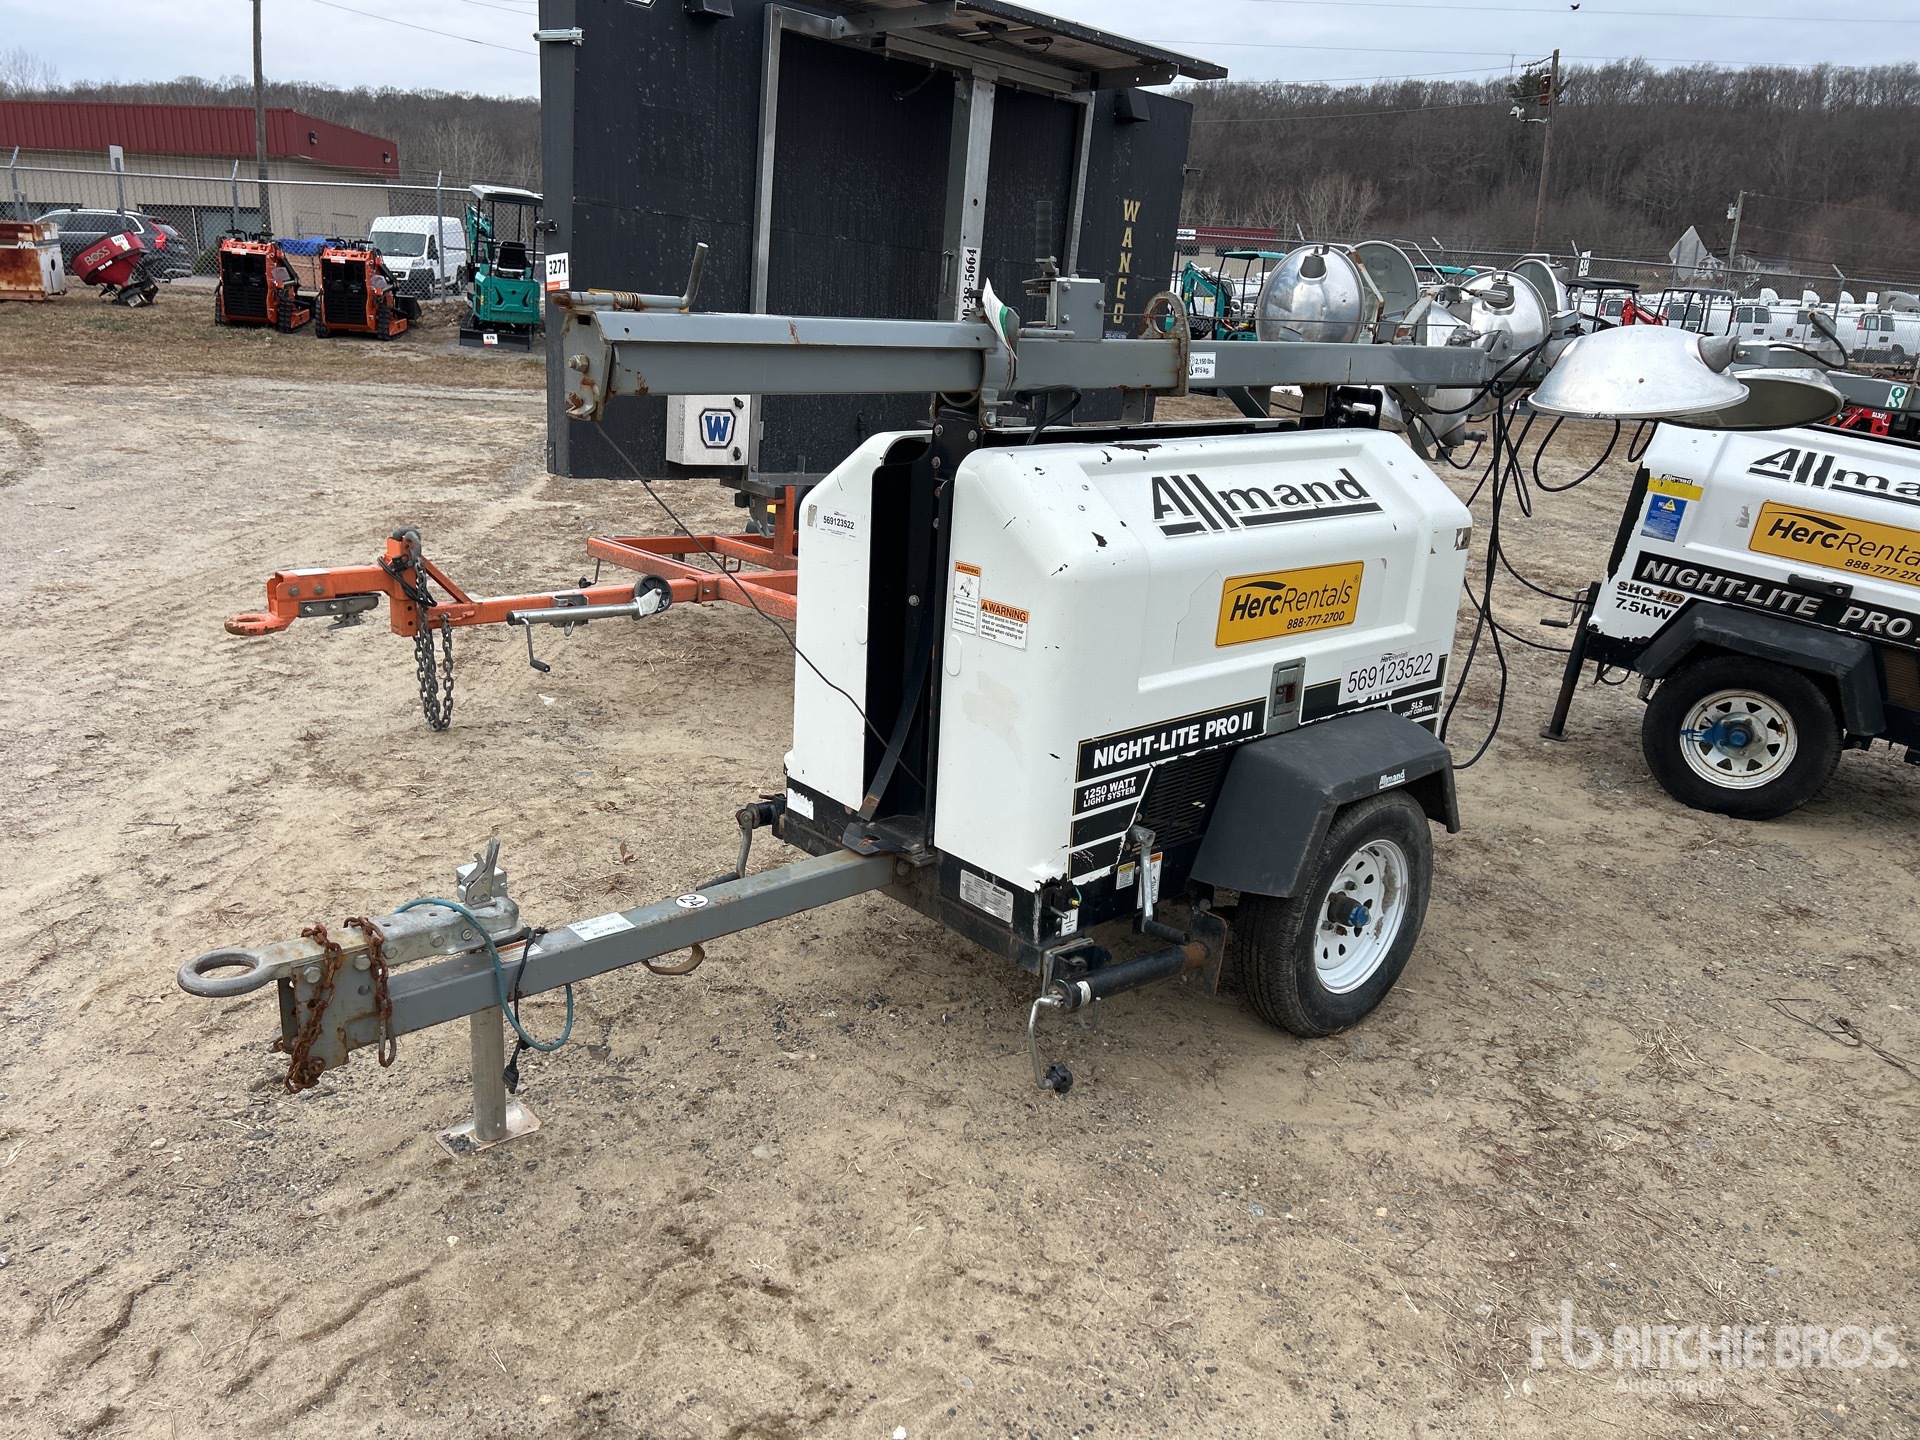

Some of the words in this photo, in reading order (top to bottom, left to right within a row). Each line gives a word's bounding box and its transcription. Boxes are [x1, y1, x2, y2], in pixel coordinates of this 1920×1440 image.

[84, 246, 111, 266] BOSS
[548, 258, 567, 275] 3271
[1113, 199, 1141, 324] WANCO
[961, 249, 977, 321] 0-28-5664
[1151, 467, 1374, 533] Allmand
[823, 515, 855, 530] 569123522
[960, 565, 979, 574] WARNING
[1230, 579, 1353, 622] HercRentals
[1617, 581, 1686, 605] SHO-HD
[1641, 560, 1823, 617] NIGHT-LITE
[1839, 606, 1913, 638] PRO
[988, 602, 1026, 622] WARNING
[1286, 610, 1345, 630] 888-777-2700
[1616, 597, 1672, 620] 7.5kW
[1347, 652, 1433, 694] 569123522
[1410, 700, 1423, 710] SLS
[1093, 723, 1201, 769] NIGHT-LITE
[1204, 715, 1240, 740] PRO
[1242, 711, 1253, 731] II
[1083, 784, 1107, 800] 1250
[1109, 776, 1137, 793] WATT
[1379, 768, 1405, 788] Allmand
[1083, 795, 1106, 808] LIGHT
[1107, 785, 1136, 800] SYSTEM
[679, 895, 703, 907] 24
